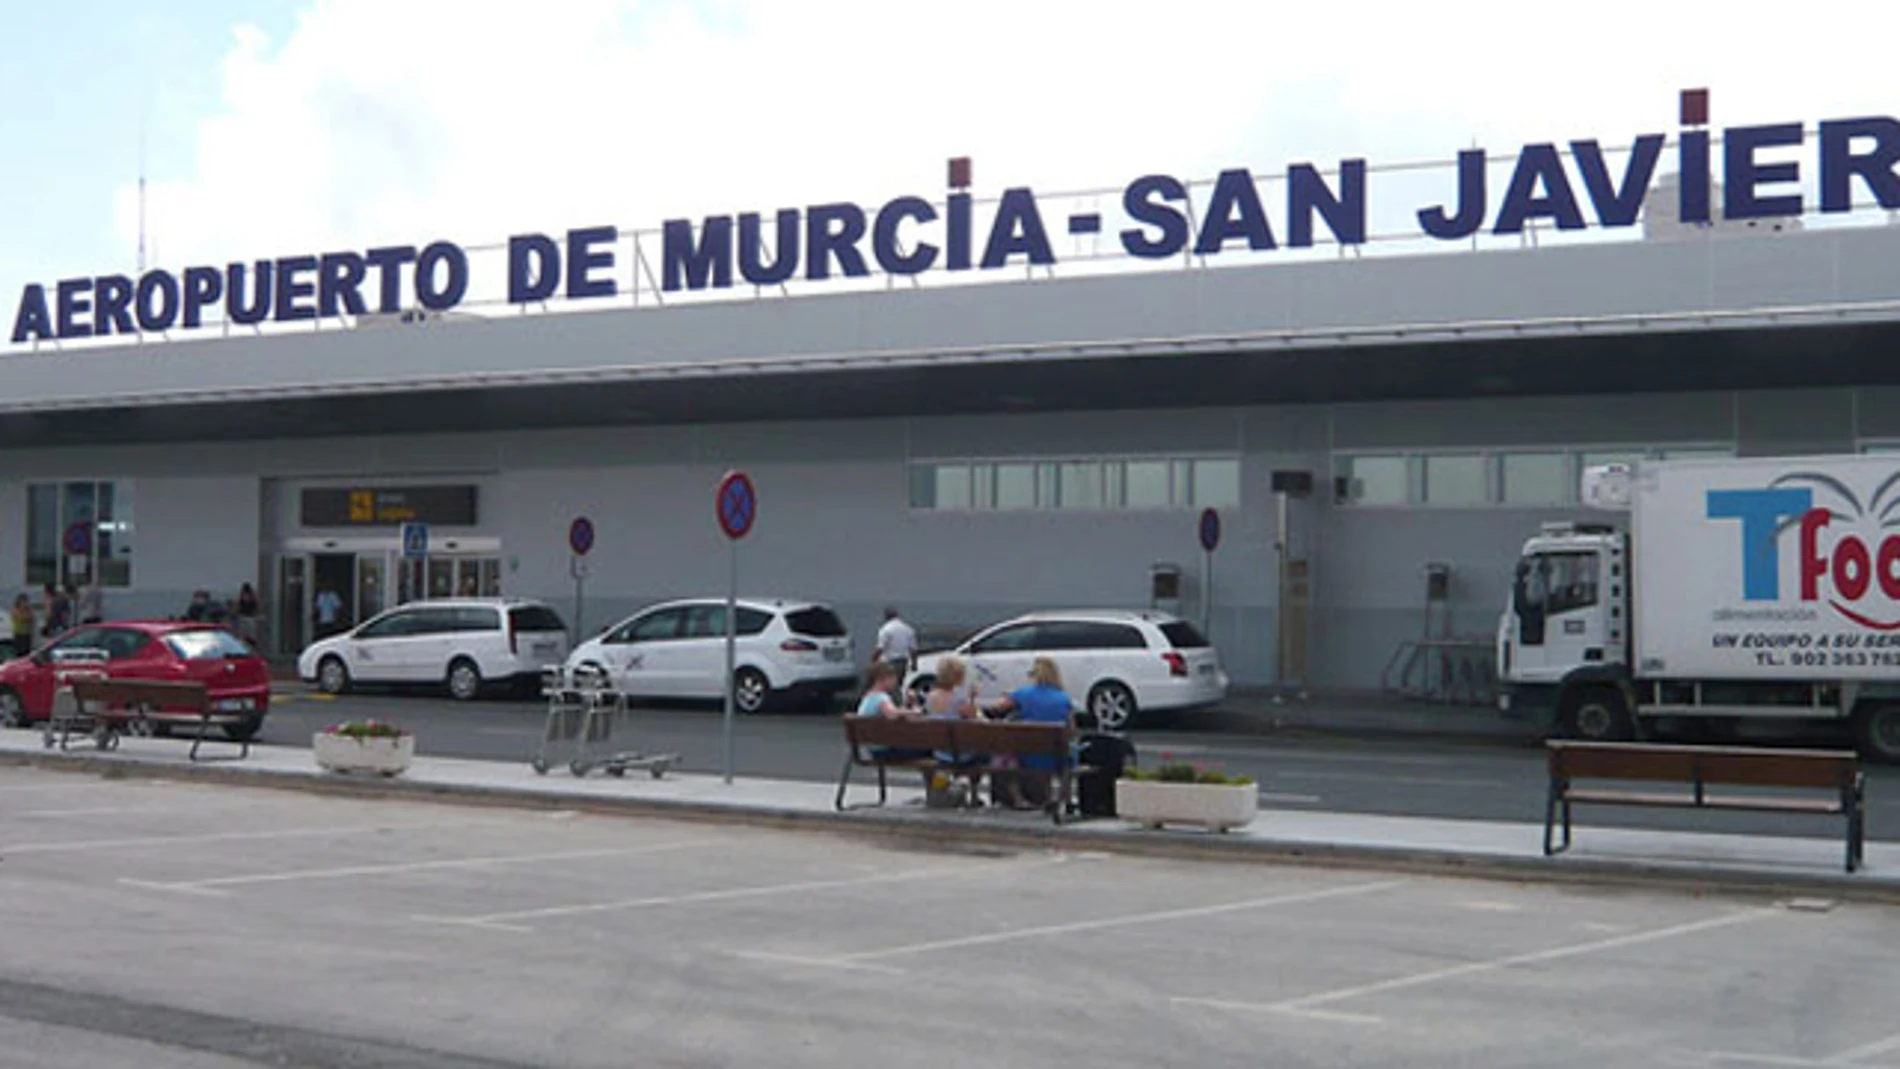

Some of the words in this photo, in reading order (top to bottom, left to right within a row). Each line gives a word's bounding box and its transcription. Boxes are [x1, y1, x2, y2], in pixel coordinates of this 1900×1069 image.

[11, 240, 468, 343] AEROPUERTO
[508, 226, 618, 304] DE
[1119, 158, 1366, 259] SAN
[1742, 632, 1813, 648] EQUIPO
[1815, 633, 1830, 648] A
[1832, 632, 1861, 648] SU
